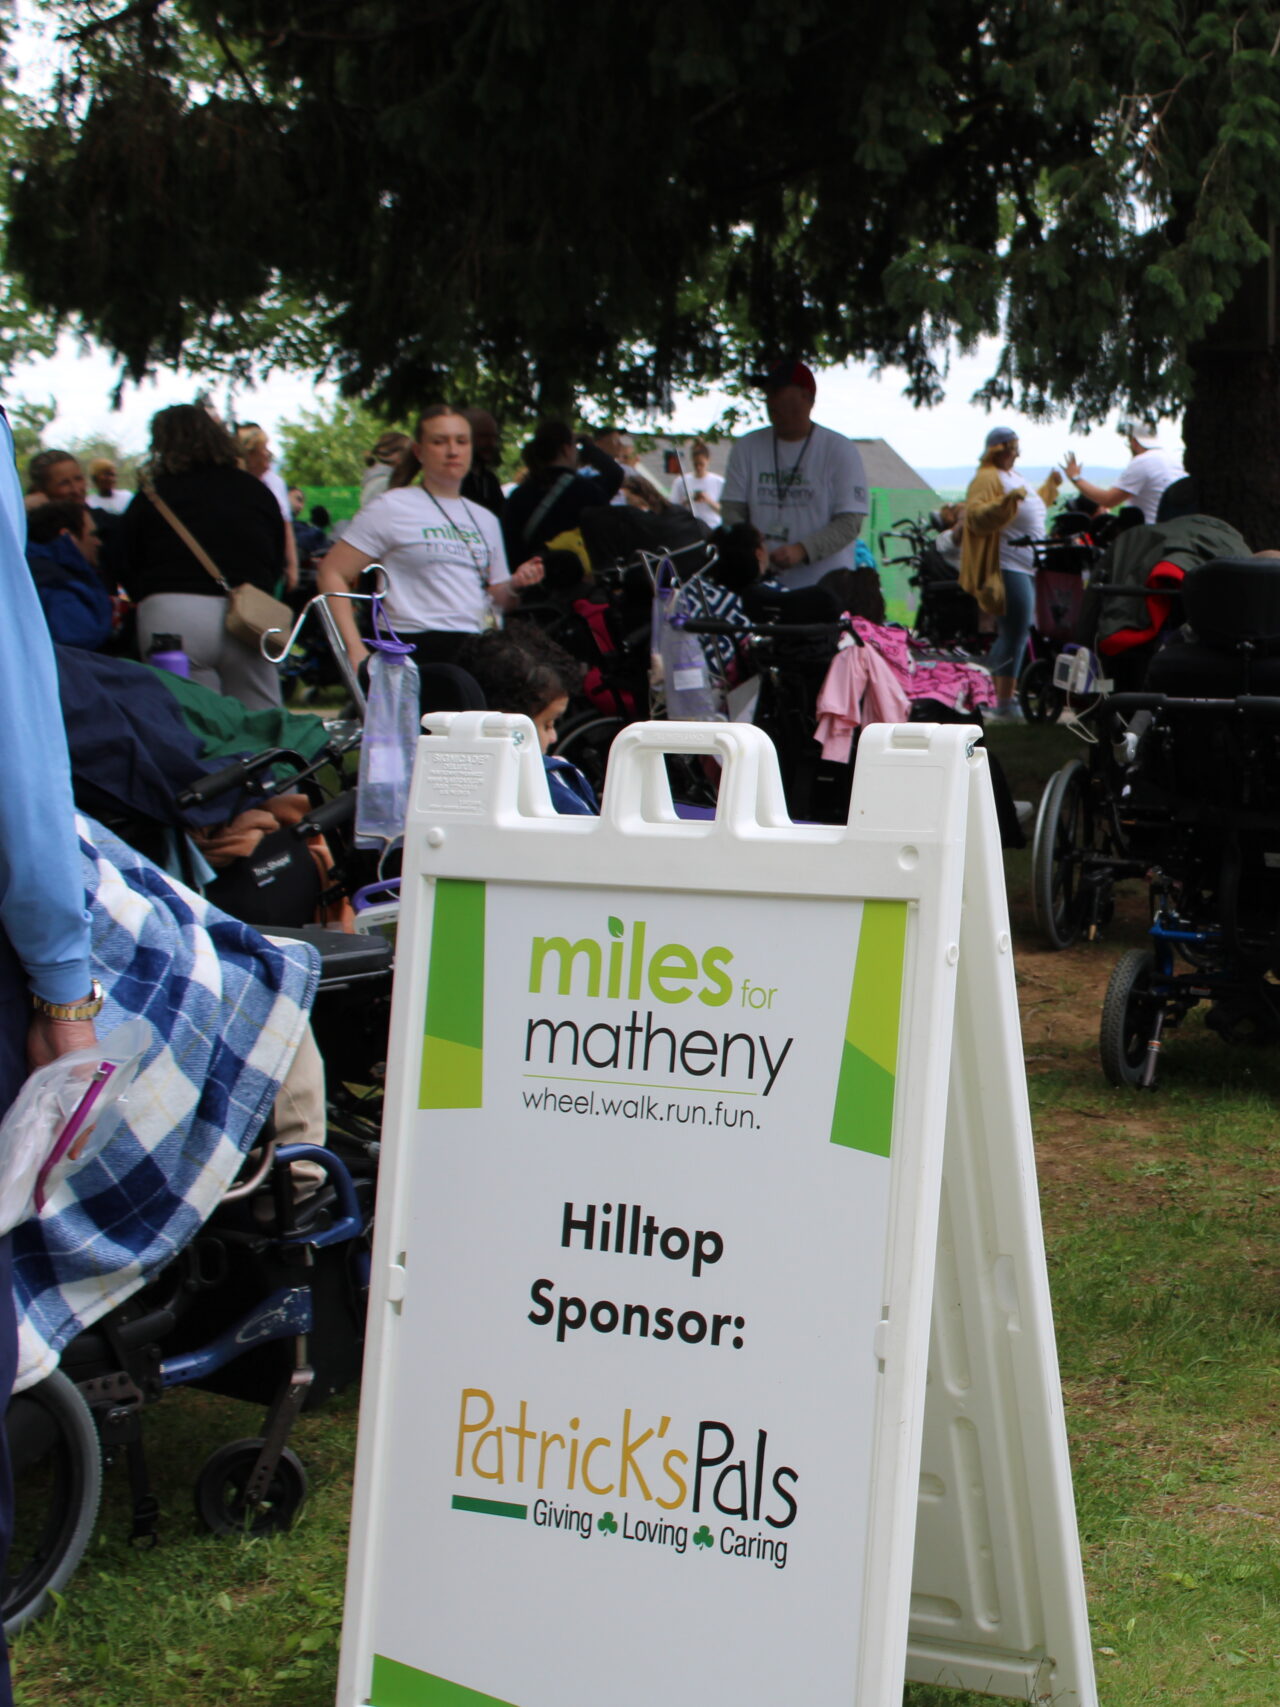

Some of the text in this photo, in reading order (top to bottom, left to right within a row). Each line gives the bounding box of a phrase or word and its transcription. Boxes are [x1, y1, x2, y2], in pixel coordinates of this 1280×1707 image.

[758, 469, 803, 486] mles
[422, 524, 482, 545] miles
[528, 914, 779, 1011] miles for
[524, 1010, 795, 1097] matheny
[521, 1087, 762, 1131] wheel.walk.run.fun.
[560, 1201, 724, 1278] Hilltop
[527, 1278, 746, 1350] Sponsor:
[455, 1387, 800, 1530] Patrick's Pals
[533, 1498, 788, 1570] Giving Loving Caring
